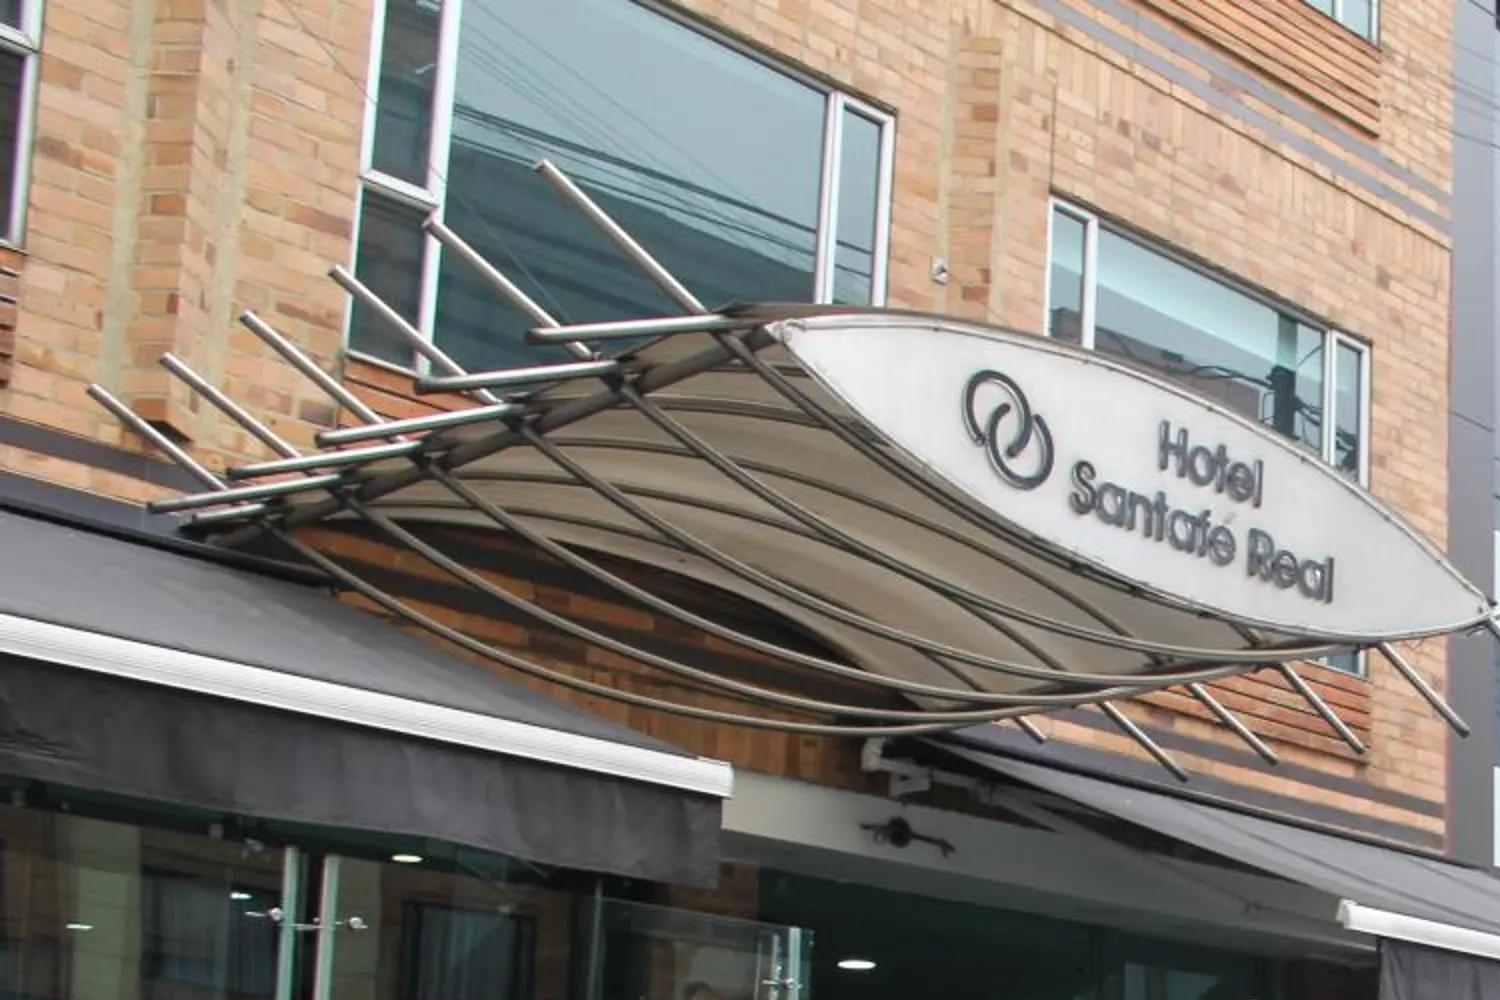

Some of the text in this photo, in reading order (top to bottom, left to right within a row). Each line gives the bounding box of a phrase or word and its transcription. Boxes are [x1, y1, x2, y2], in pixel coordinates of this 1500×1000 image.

[1158, 420, 1264, 509] Hotel
[1068, 460, 1335, 605] Santafé Real
